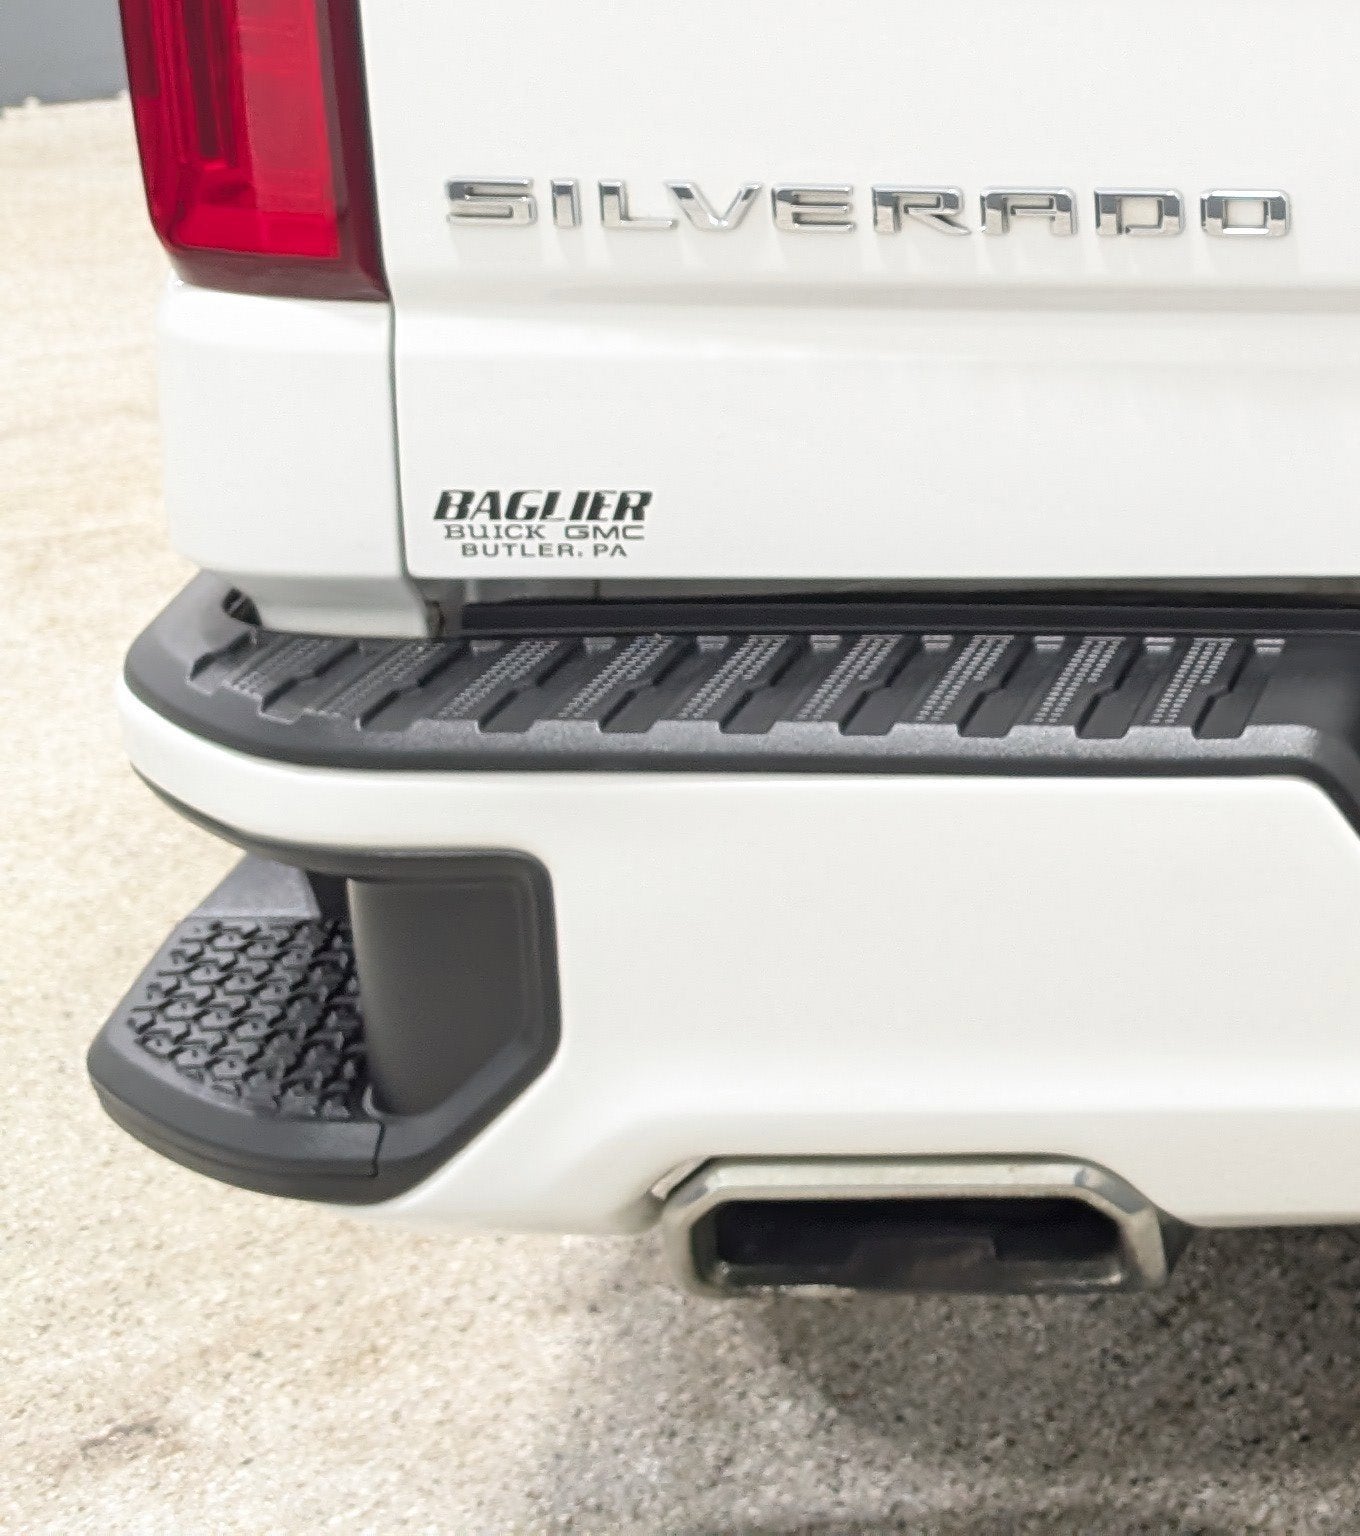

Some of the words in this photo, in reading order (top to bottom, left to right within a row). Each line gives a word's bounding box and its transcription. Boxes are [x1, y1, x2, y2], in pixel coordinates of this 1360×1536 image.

[445, 175, 1293, 239] SILVERADO
[433, 489, 653, 521] BAGLIER
[444, 524, 545, 540] BUICK
[564, 525, 645, 540] GMC
[593, 544, 628, 558] PA
